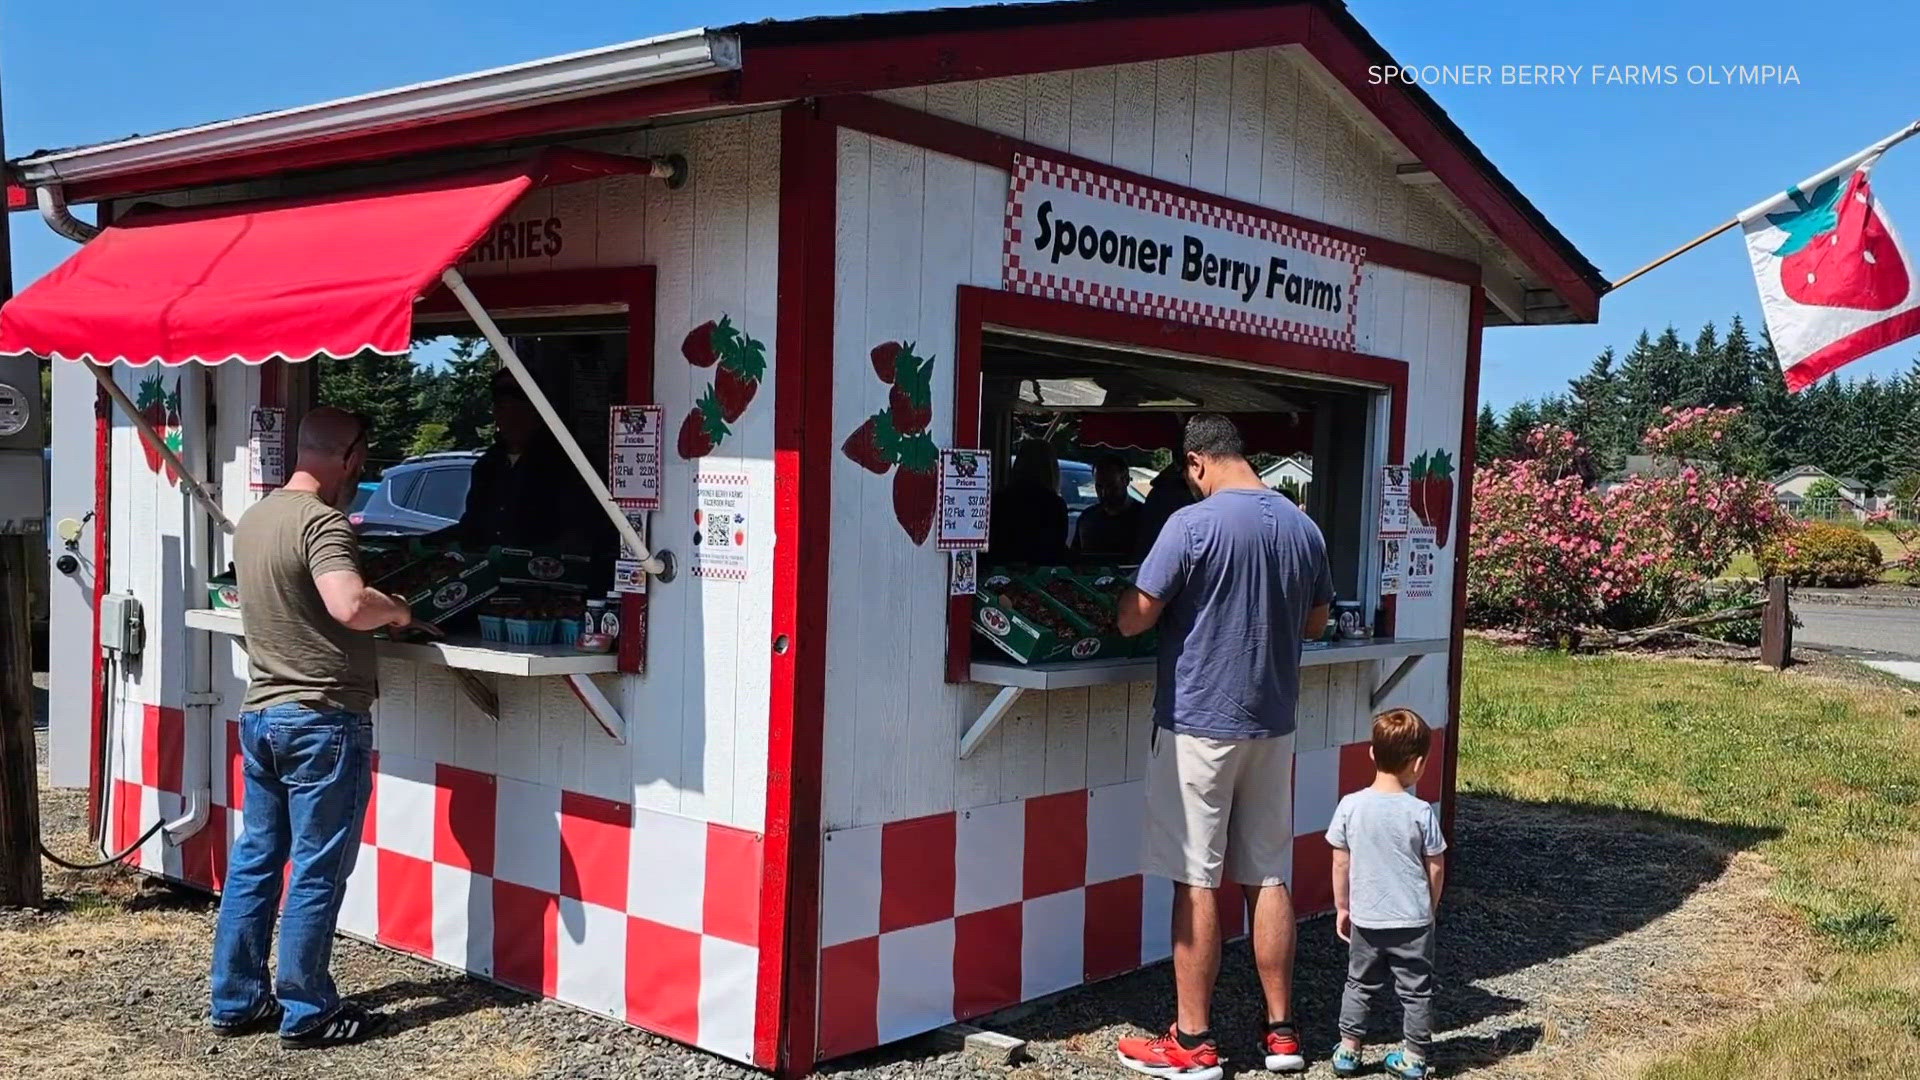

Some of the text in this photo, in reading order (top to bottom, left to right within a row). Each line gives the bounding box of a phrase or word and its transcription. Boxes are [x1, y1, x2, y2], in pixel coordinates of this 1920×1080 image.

[1034, 201, 1342, 314] Spooner Berry Farms
[955, 479, 977, 487] Prices
